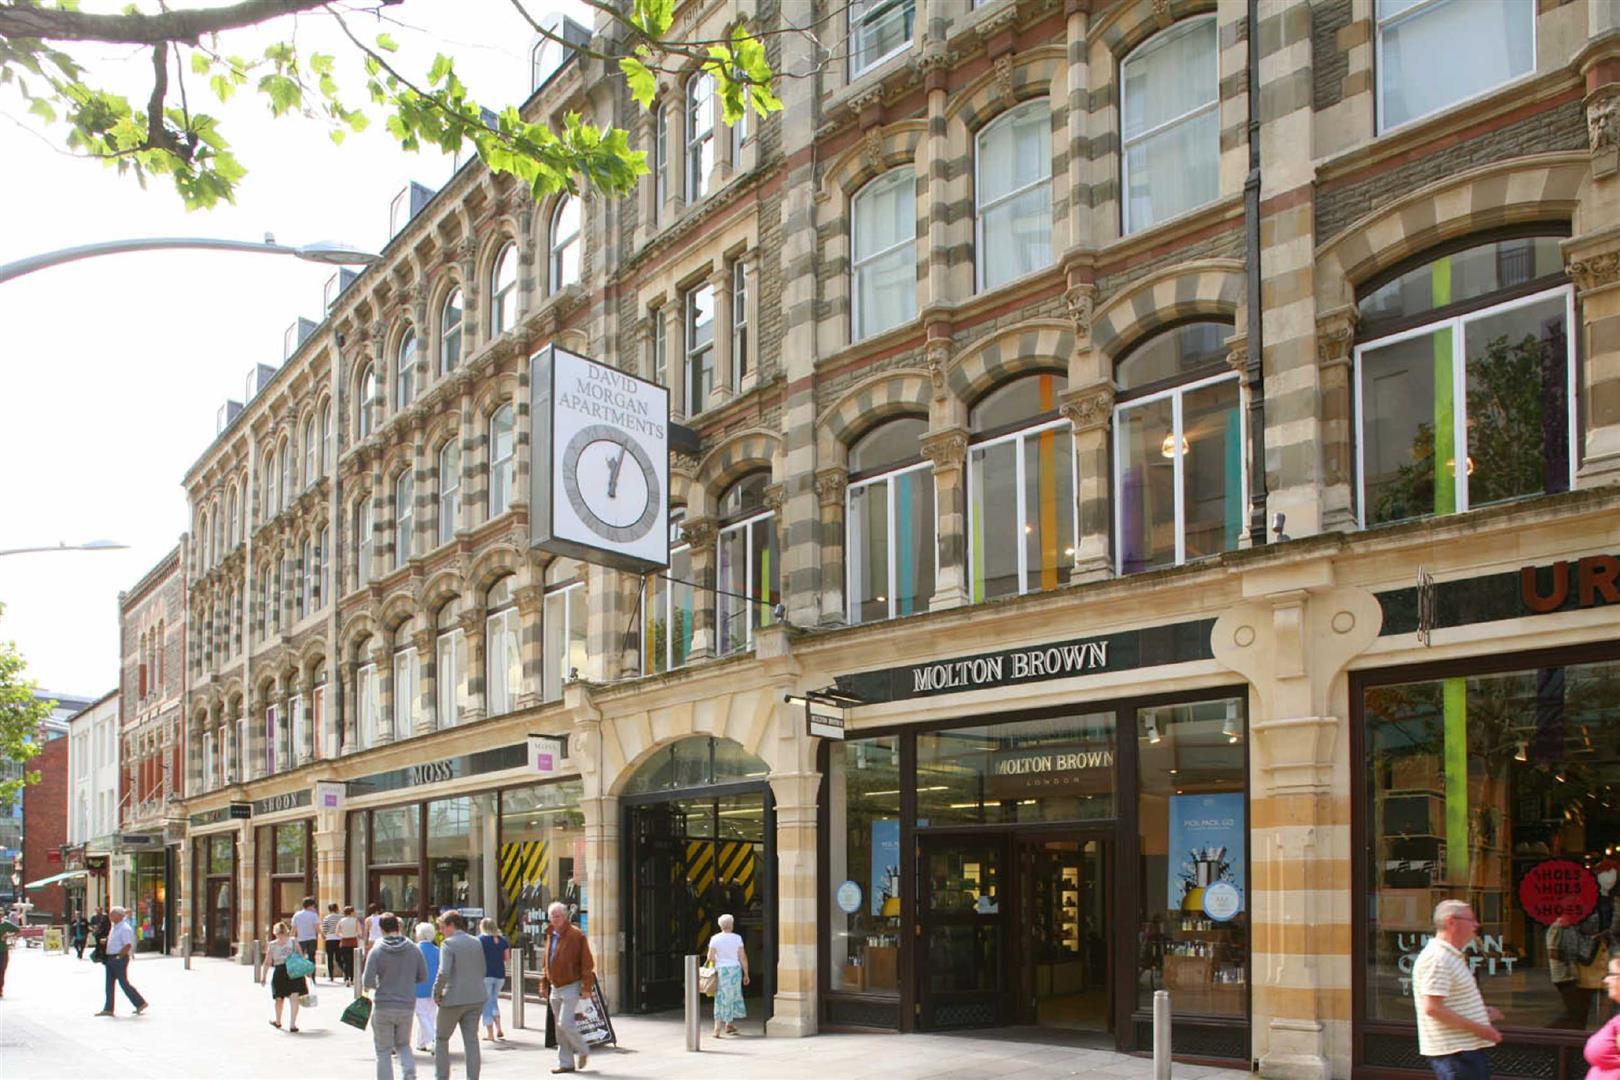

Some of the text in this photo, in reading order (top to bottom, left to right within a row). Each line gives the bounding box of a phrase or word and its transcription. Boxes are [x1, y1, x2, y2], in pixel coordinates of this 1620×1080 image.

[588, 365, 638, 393] DAVID
[577, 379, 648, 416] MORGAN
[560, 392, 664, 439] APARTMENTS
[912, 640, 1110, 693] MOLTON BROWN
[411, 761, 452, 785] MOSS
[994, 751, 1114, 775] MOLTON BROWN
[262, 793, 298, 813] SHOON
